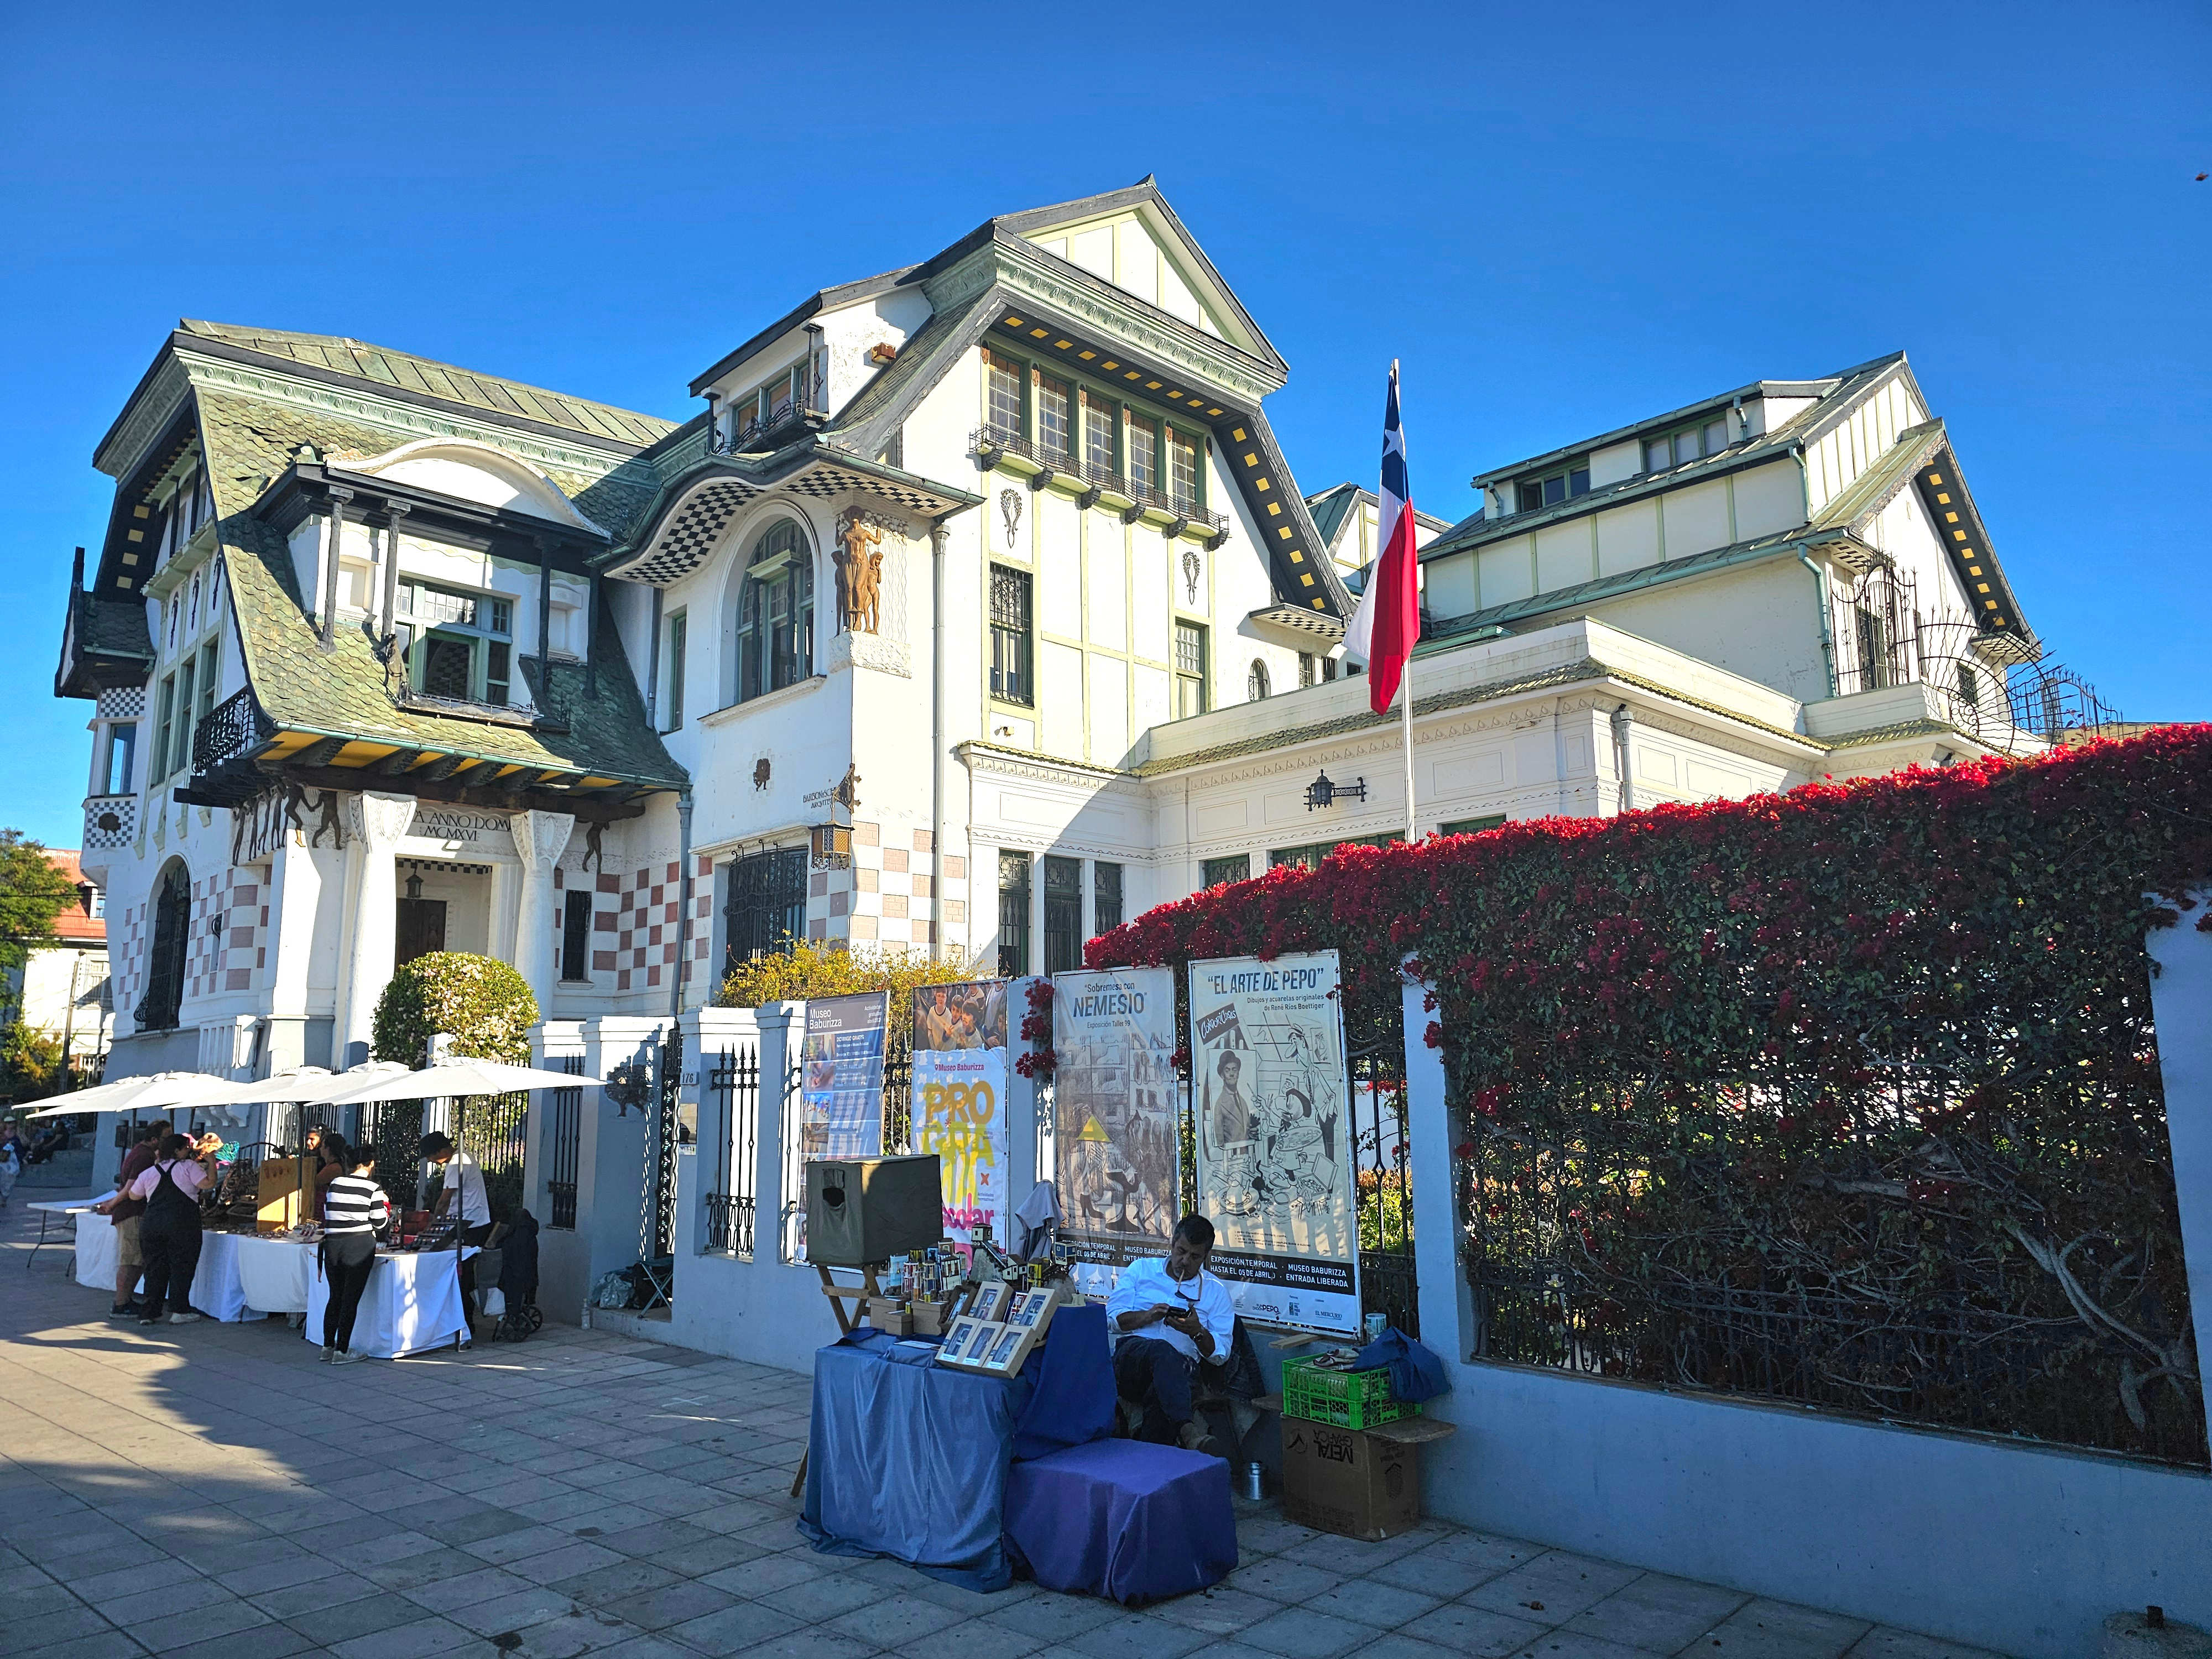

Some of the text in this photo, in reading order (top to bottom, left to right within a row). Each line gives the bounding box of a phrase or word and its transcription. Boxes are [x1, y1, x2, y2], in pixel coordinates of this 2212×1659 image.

[429, 812, 470, 828] ANNO
[424, 826, 477, 841] MCMXVI
[1230, 972, 1260, 993] ARTE
[1263, 971, 1279, 991] DE
[1296, 993, 1324, 1001] originales
[810, 1009, 831, 1019] Museo
[809, 1019, 842, 1029] Baburizza
[682, 1073, 693, 1083] 176
[923, 1081, 994, 1124] PRO
[1090, 1243, 1117, 1251] TEMPORAL
[1144, 1248, 1172, 1256] BABURIZZA
[1211, 1255, 1277, 1269] EXPOSICIÓN TEMPORAL
[1210, 1265, 1228, 1274] HASTA
[1288, 1264, 1347, 1277] MUSEO BABURIZZA
[1286, 1274, 1348, 1288] ENTRADA LIBERADA
[1313, 1440, 1353, 1464] METAL
